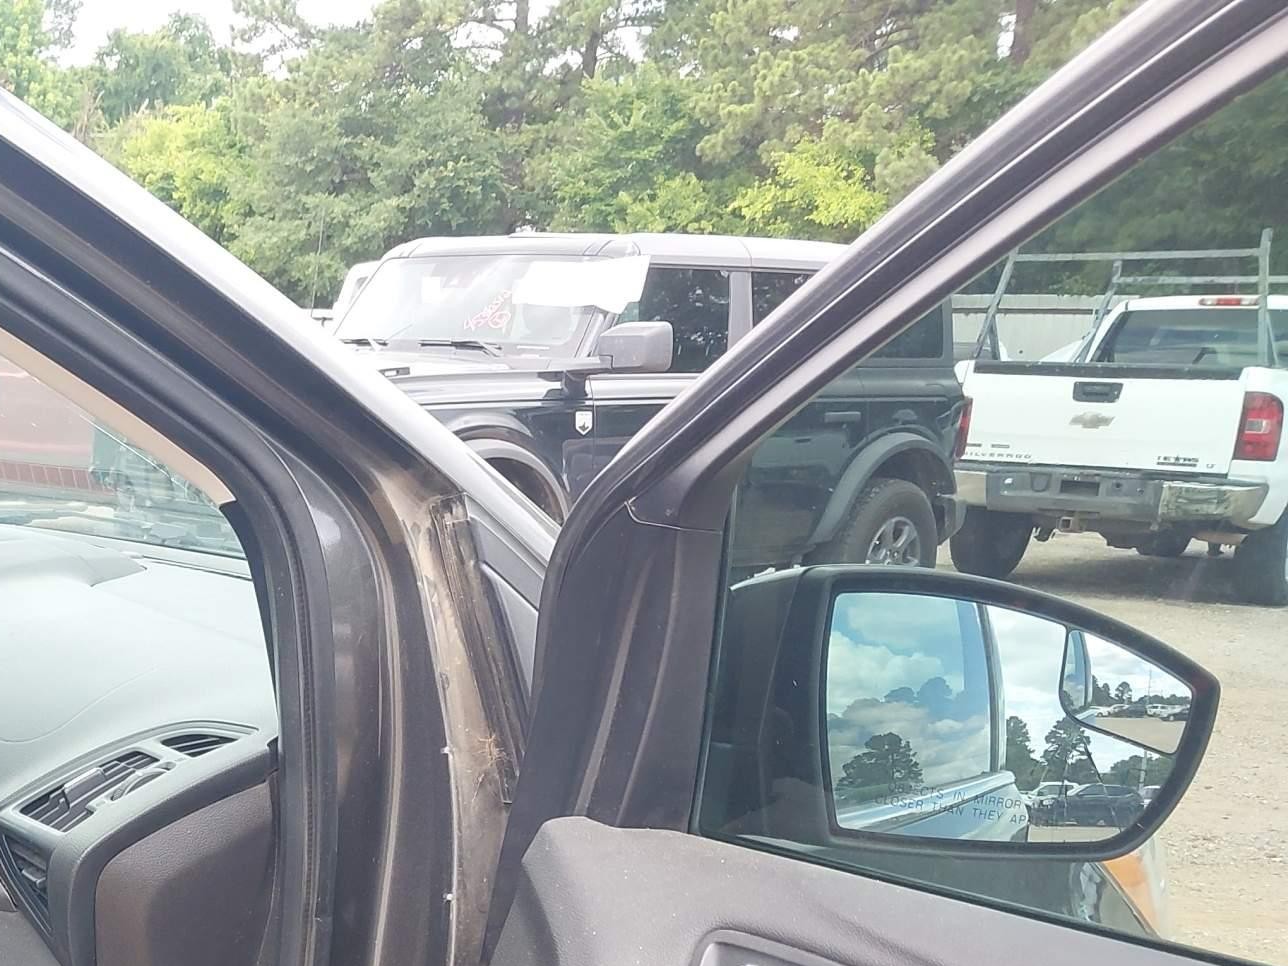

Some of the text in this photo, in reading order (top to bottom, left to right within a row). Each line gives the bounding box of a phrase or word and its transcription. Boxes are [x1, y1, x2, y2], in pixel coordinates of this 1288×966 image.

[875, 795, 923, 810] CLOSER
[973, 807, 1004, 821] THEY
[975, 794, 1021, 809] MIRROR
